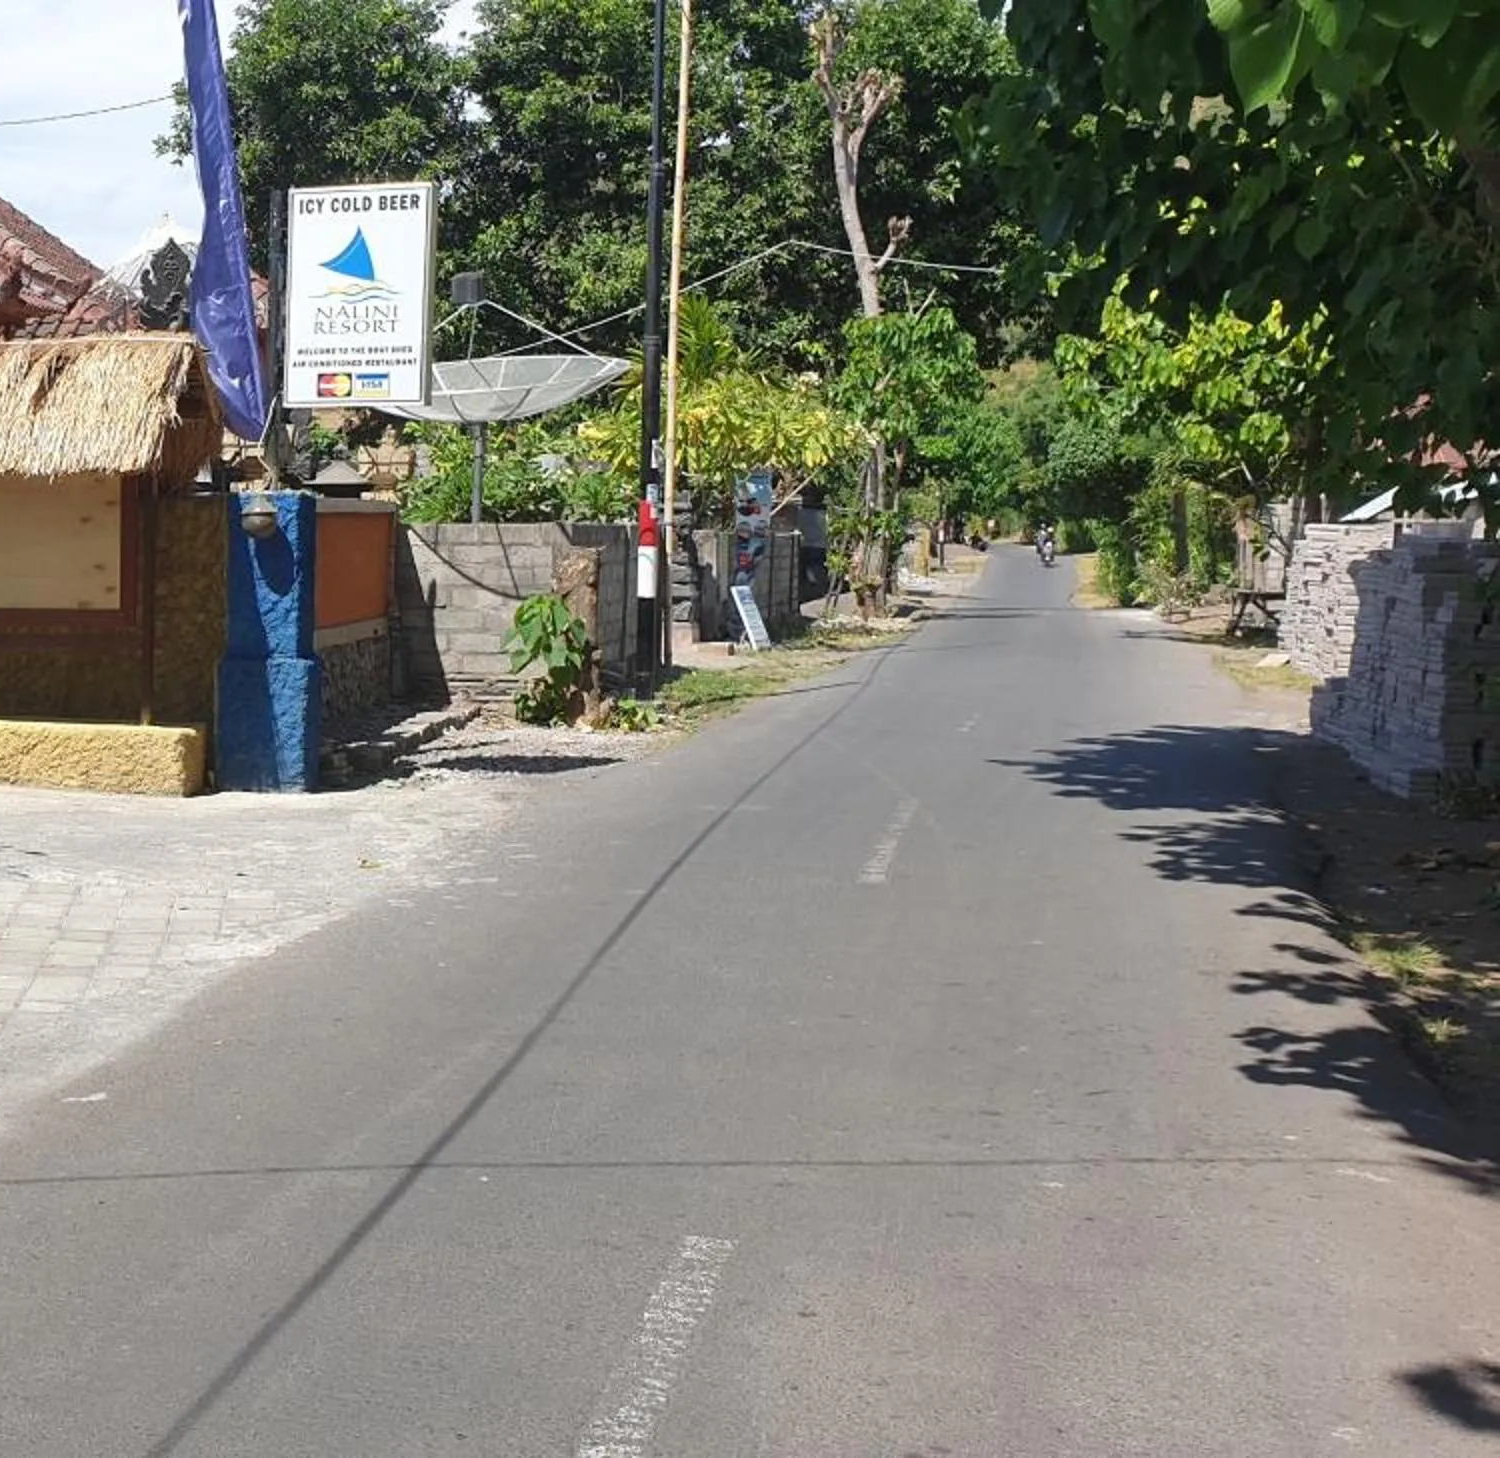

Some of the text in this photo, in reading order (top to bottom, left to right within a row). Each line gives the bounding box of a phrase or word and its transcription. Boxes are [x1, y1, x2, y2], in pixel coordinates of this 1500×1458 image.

[299, 194, 420, 215] ICY COLD BEER
[316, 304, 398, 319] NALINI
[314, 319, 399, 334] RESORT
[297, 347, 336, 356] WELCOME
[339, 347, 349, 355] TO
[351, 346, 365, 354] THE
[368, 346, 389, 354] BOAT
[292, 360, 306, 368] AIR
[361, 381, 383, 389] VISA
